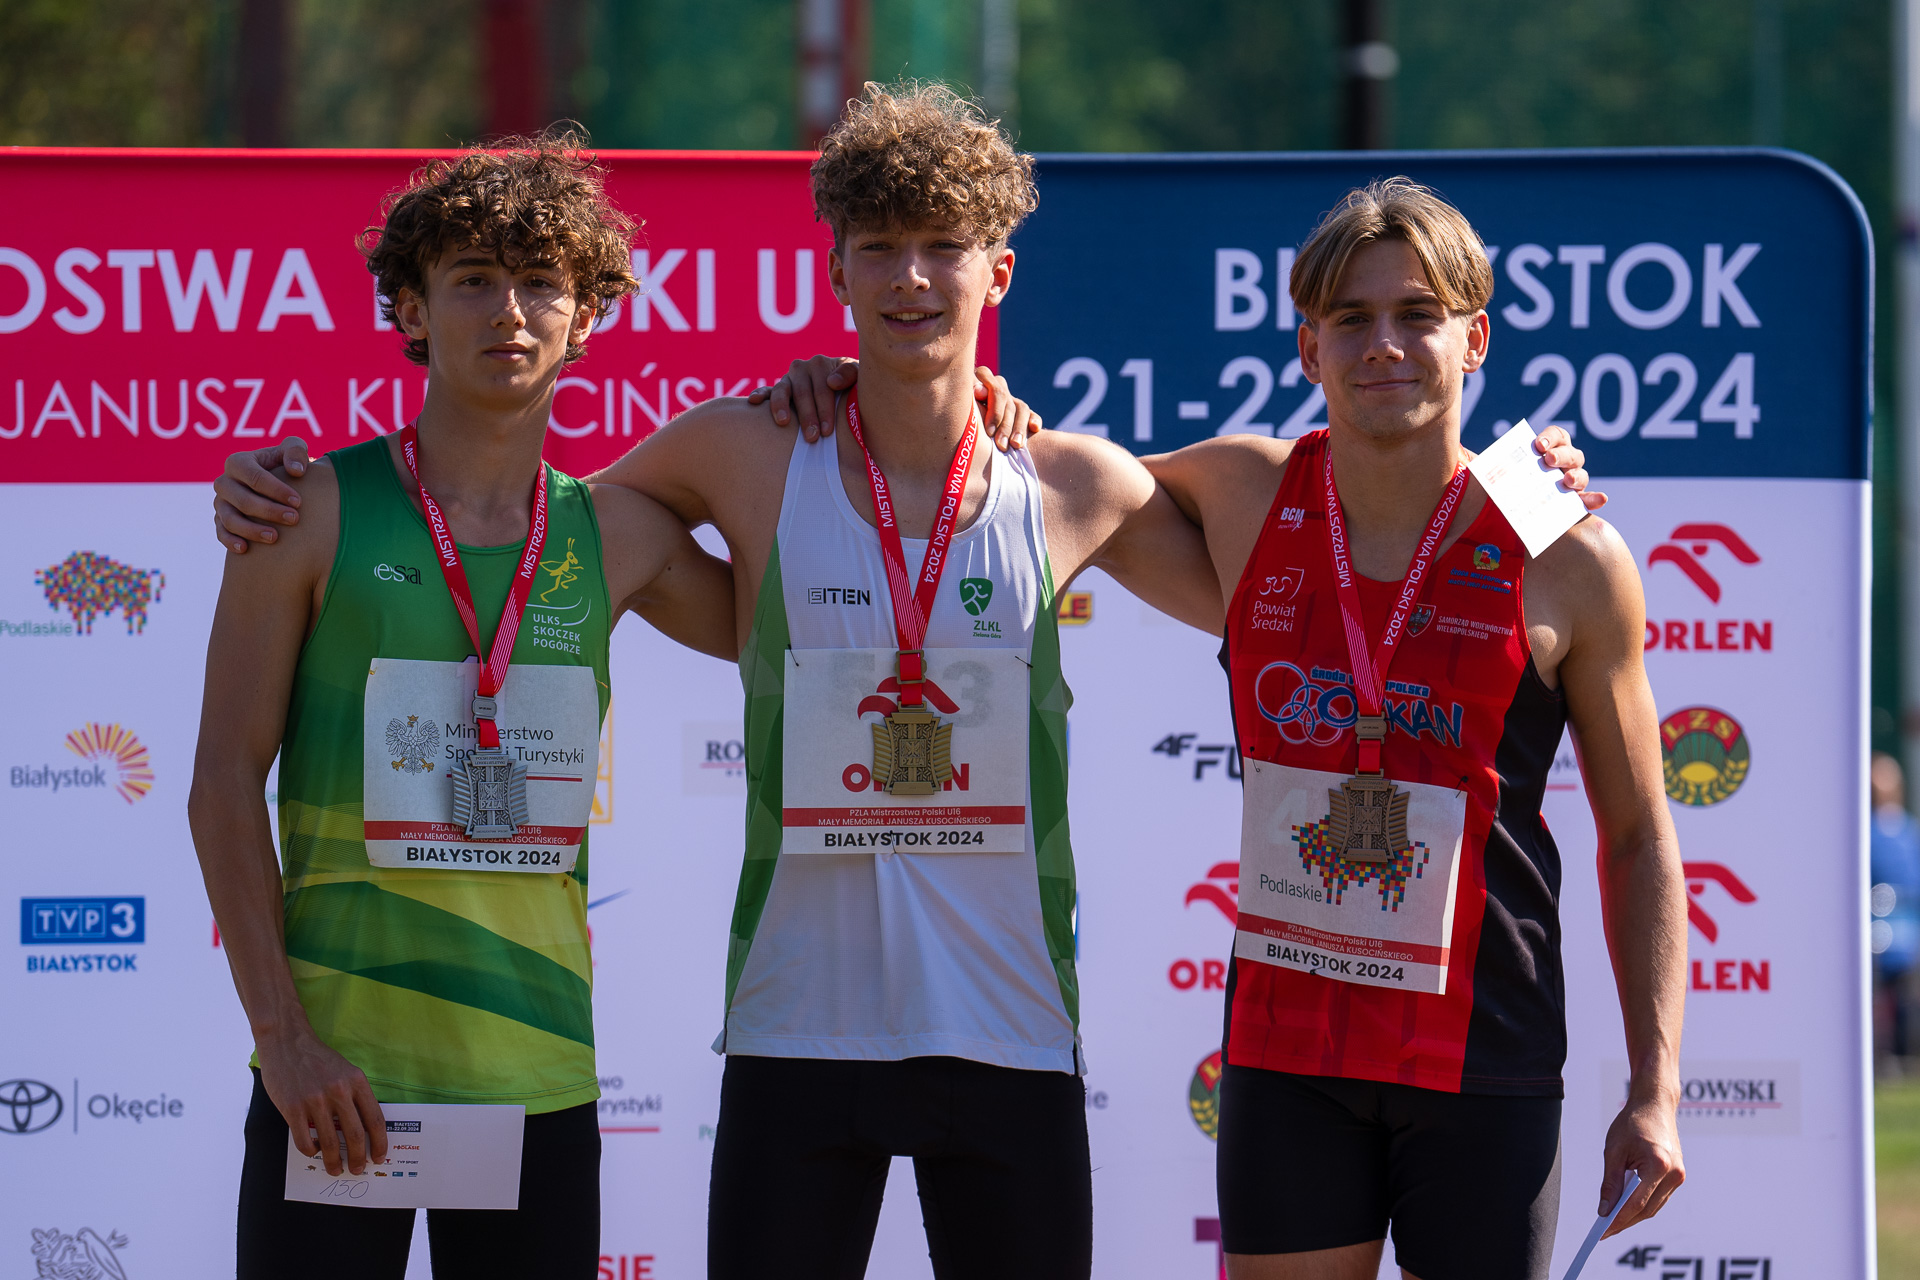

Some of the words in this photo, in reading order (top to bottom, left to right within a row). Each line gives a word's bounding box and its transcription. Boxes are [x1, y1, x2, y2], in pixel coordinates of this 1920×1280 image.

[1280, 507, 1305, 521] BCM
[1419, 462, 1466, 557] MISTRZOSTWA
[933, 496, 957, 547] POLSKI
[521, 489, 546, 579] MISTRZOSTWA
[1327, 486, 1351, 588] MISTRZOSTWA
[924, 547, 943, 583] 2024
[1399, 558, 1426, 614] POLSKI
[1254, 601, 1296, 618] Powiat
[533, 613, 560, 626] ULKS
[974, 620, 1001, 632] ZLKL
[1251, 612, 1293, 632] Średzki
[1383, 610, 1406, 646] 2024
[1470, 621, 1513, 636] WOJEWÓDZTWA
[533, 626, 581, 643] SKOCZEK
[533, 637, 581, 655] POGÓRZE
[445, 723, 554, 740] Minerstwo
[515, 746, 584, 765] Turystyki
[10, 764, 106, 793] Białystok
[818, 818, 840, 826] MAŁY
[842, 818, 885, 826] MEMORIAŁ
[886, 817, 924, 825] JANUSZA
[925, 815, 992, 825] KUSOCIŃSKIEGO
[850, 809, 869, 817] PZLA
[871, 808, 920, 816] Mistrzostwa
[922, 808, 946, 816] Polski
[947, 807, 961, 815] U16
[431, 823, 450, 832] PZLA
[400, 832, 422, 840] MAŁY
[424, 833, 465, 841] MEMORIAŁ
[506, 834, 568, 845] KUSOCIŃSKIEGO
[825, 831, 932, 847] BIAŁYSTOK
[937, 831, 985, 846] 2024
[406, 847, 512, 864] BIAŁYSTOK
[517, 851, 561, 866] 2024
[1260, 873, 1323, 902] Podlaskie
[37, 909, 100, 933] TVP
[1263, 928, 1281, 937] MAŁY
[1281, 931, 1315, 946] MEMORIAŁ
[1315, 940, 1345, 953] JANUSZA
[1346, 946, 1414, 961] KUSOCIŃSKIEGO
[1287, 924, 1303, 934] PZLA
[1303, 928, 1342, 943] Mistrzostwa
[1343, 936, 1367, 947] Polski
[1369, 940, 1383, 948] U16
[27, 954, 138, 973] BIAŁYSTOK
[1266, 943, 1352, 975] BIAŁYSTOK
[1355, 962, 1404, 982] 2024
[88, 1093, 184, 1124] Okęcie
[320, 1180, 369, 1199] 150
